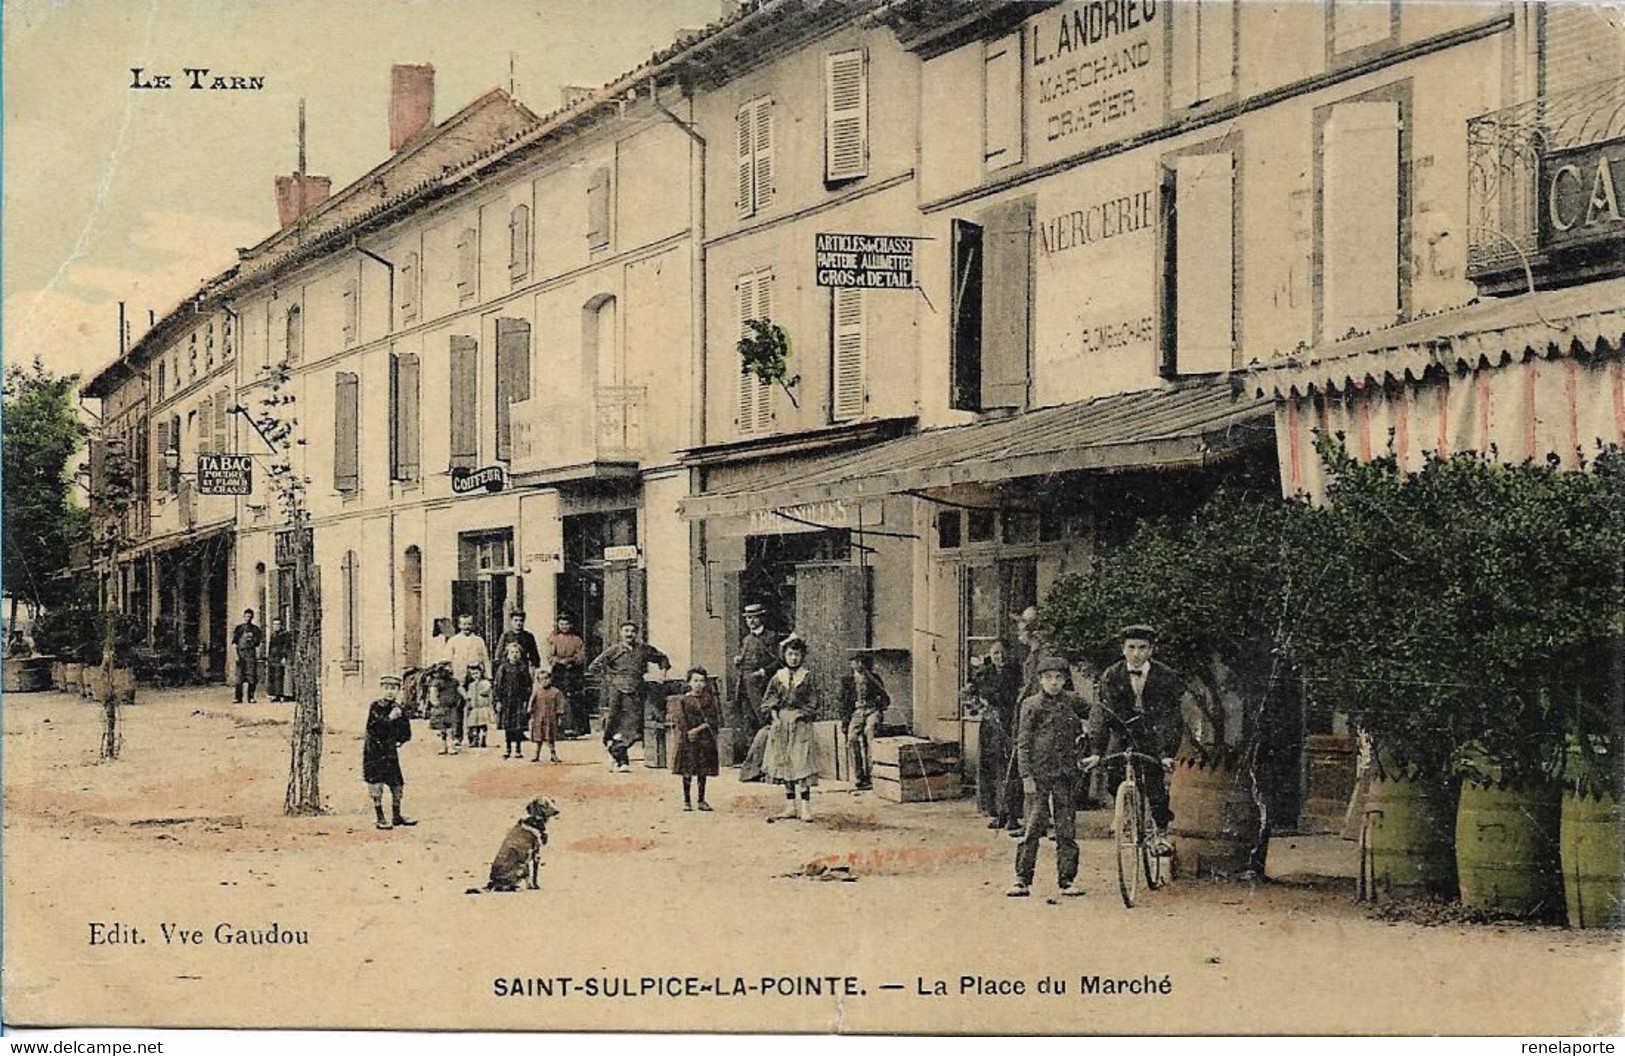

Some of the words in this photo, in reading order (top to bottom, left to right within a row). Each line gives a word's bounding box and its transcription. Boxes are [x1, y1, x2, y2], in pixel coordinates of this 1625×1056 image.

[1057, 0, 1156, 58] ANDRIEU
[1039, 40, 1152, 104] MARCHAND
[1047, 88, 1136, 141] DRAPIER
[1041, 191, 1152, 254] MERCERIE
[817, 235, 866, 252] ARTICLES
[875, 237, 913, 253] CHASSE
[819, 269, 855, 286] GROS
[200, 456, 251, 471] TABAC
[454, 469, 501, 490] COIFFEUR
